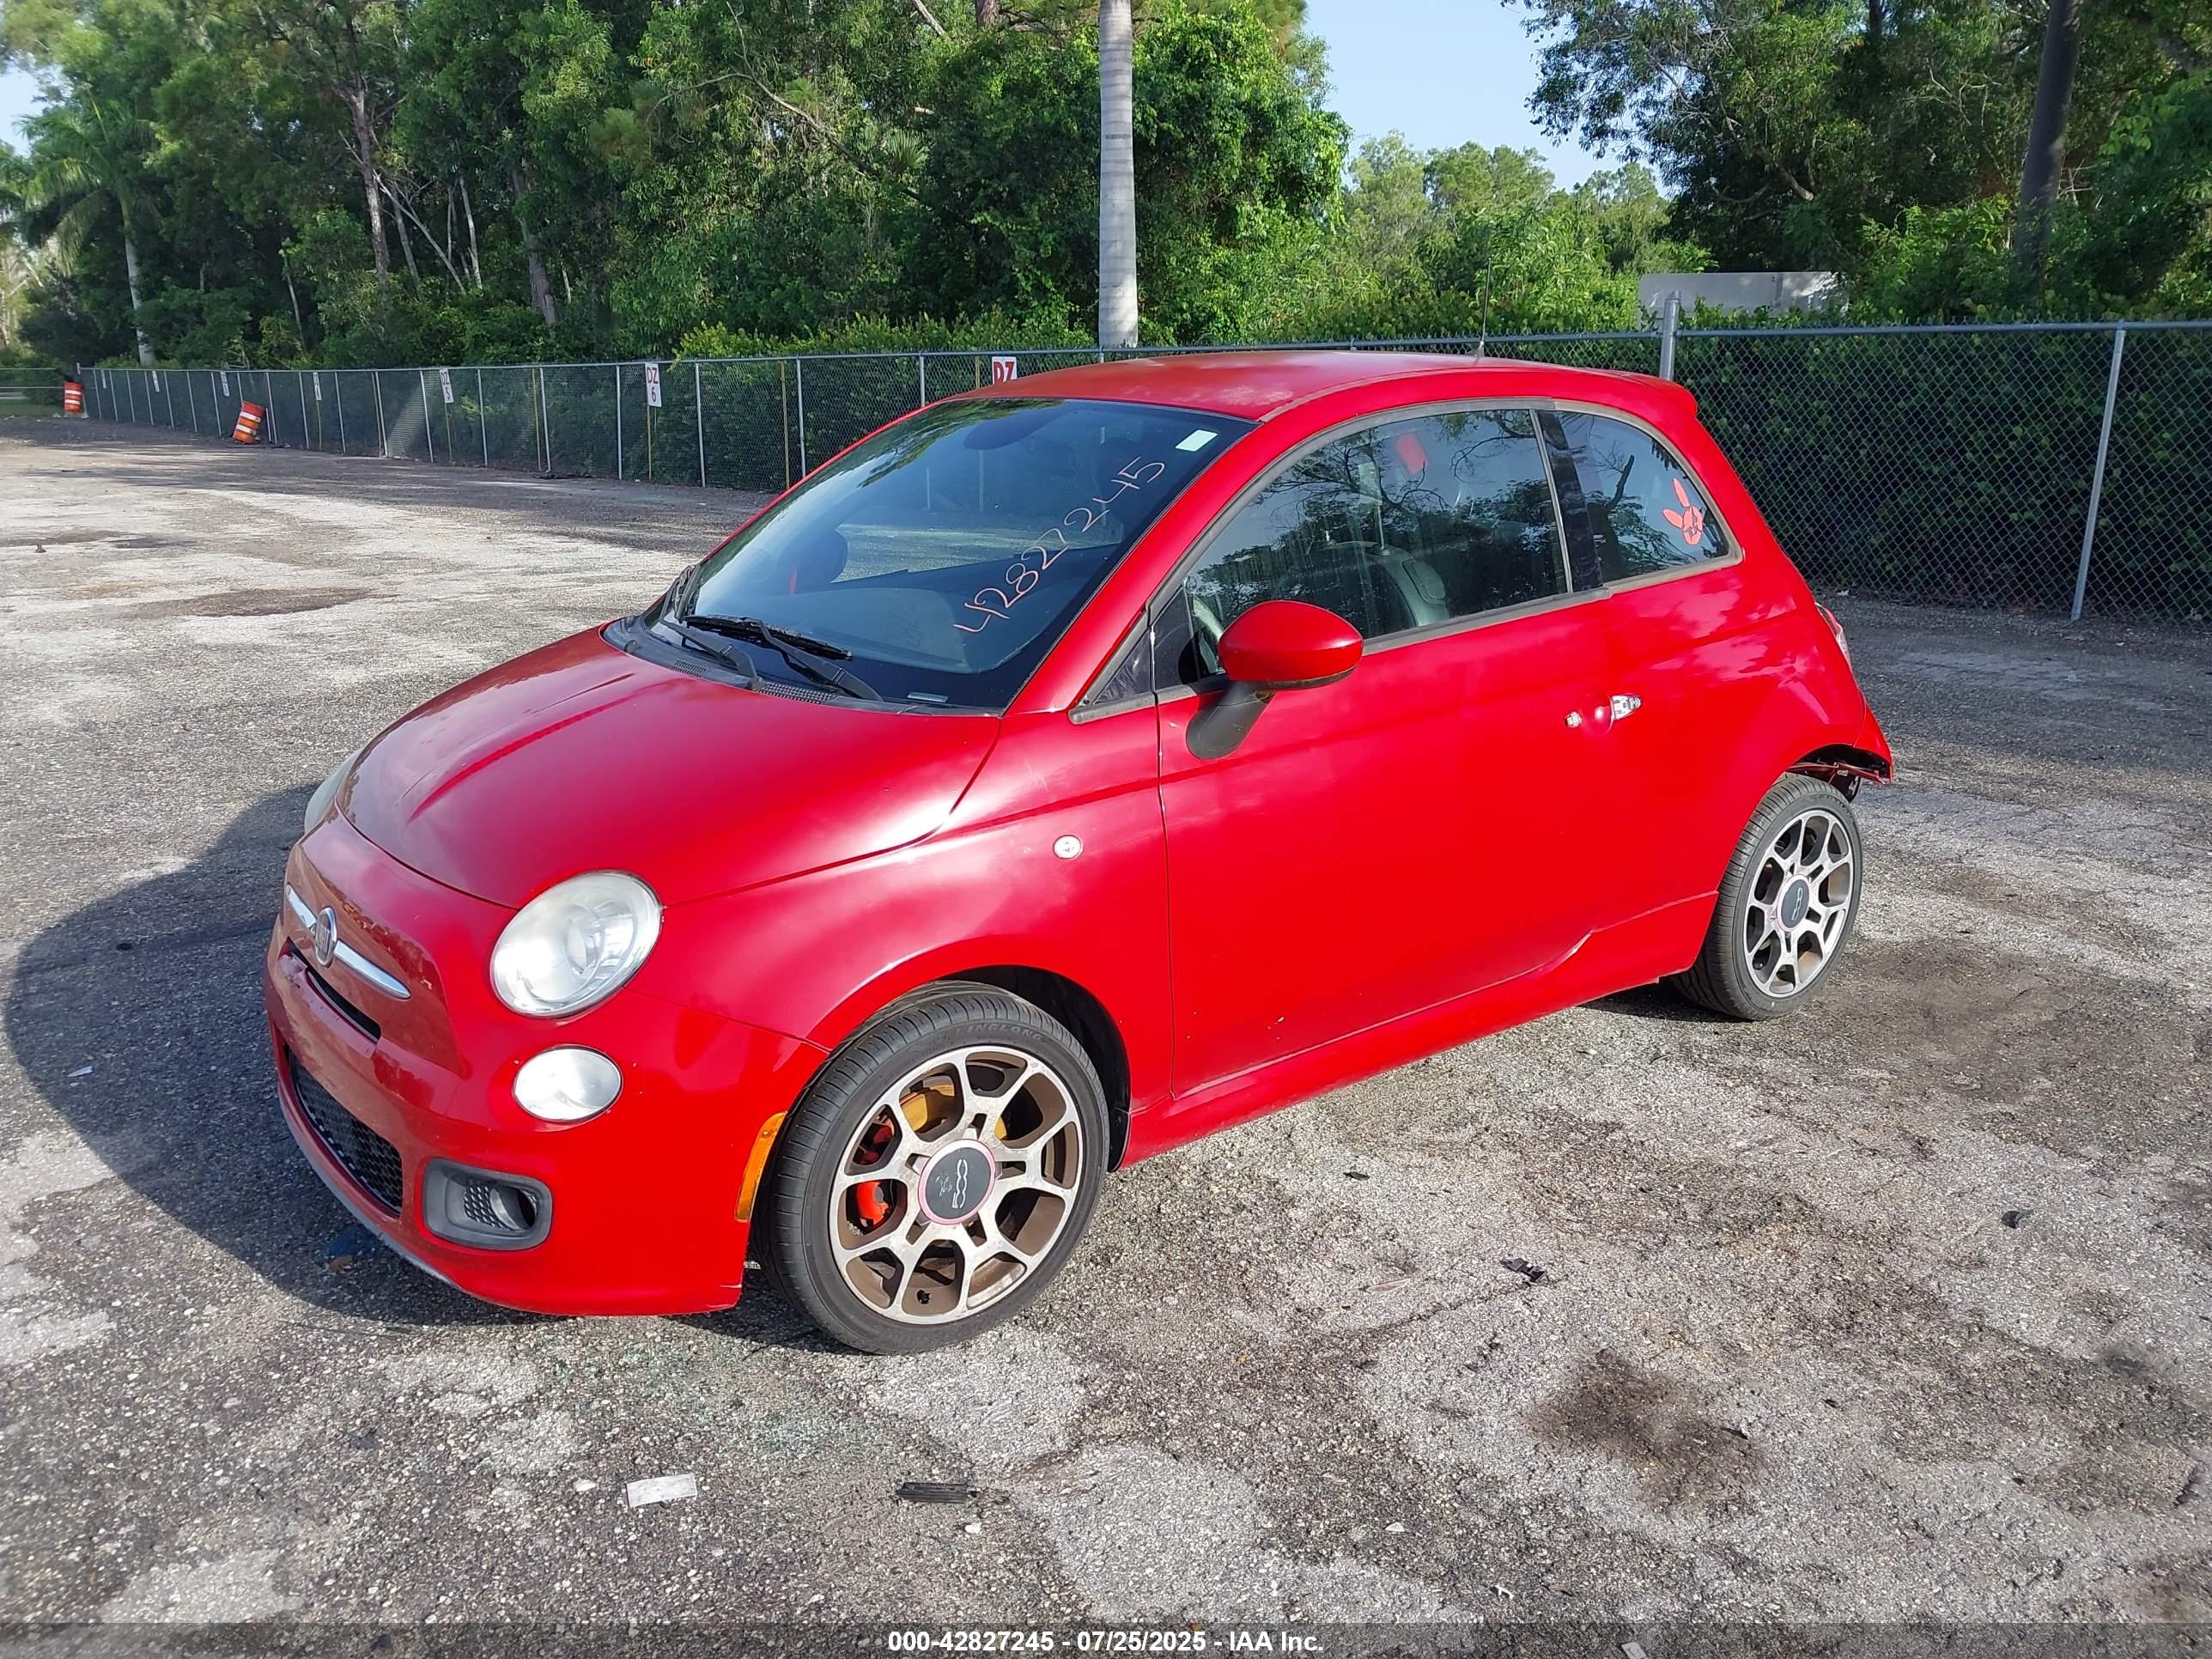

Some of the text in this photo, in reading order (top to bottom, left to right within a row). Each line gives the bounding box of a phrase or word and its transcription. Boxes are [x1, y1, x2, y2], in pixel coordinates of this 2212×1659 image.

[646, 367, 659, 384] DZ
[993, 361, 1015, 385] DZ
[651, 386, 657, 403] 6
[951, 456, 1165, 633] 42827245
